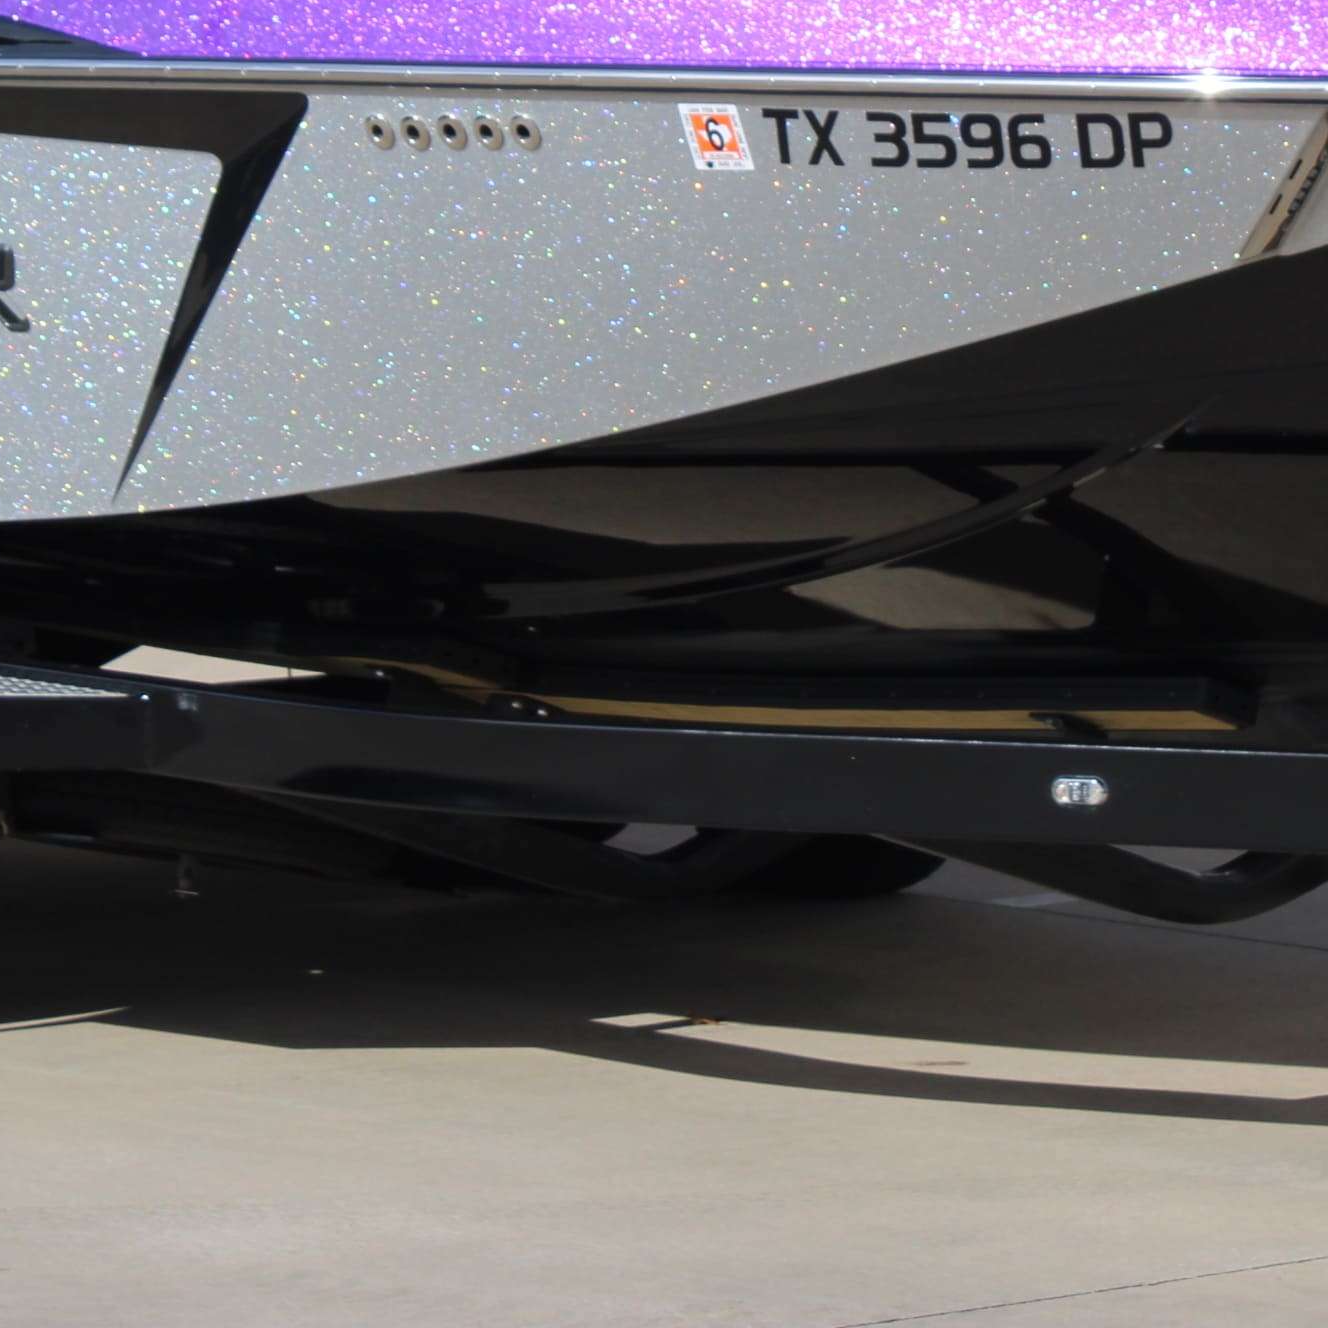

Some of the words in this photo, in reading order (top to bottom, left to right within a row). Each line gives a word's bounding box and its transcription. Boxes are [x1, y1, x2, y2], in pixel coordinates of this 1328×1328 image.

[705, 118, 725, 151] 6
[761, 108, 845, 167] TX
[866, 111, 1053, 169] 3596
[1076, 112, 1174, 169] DP
